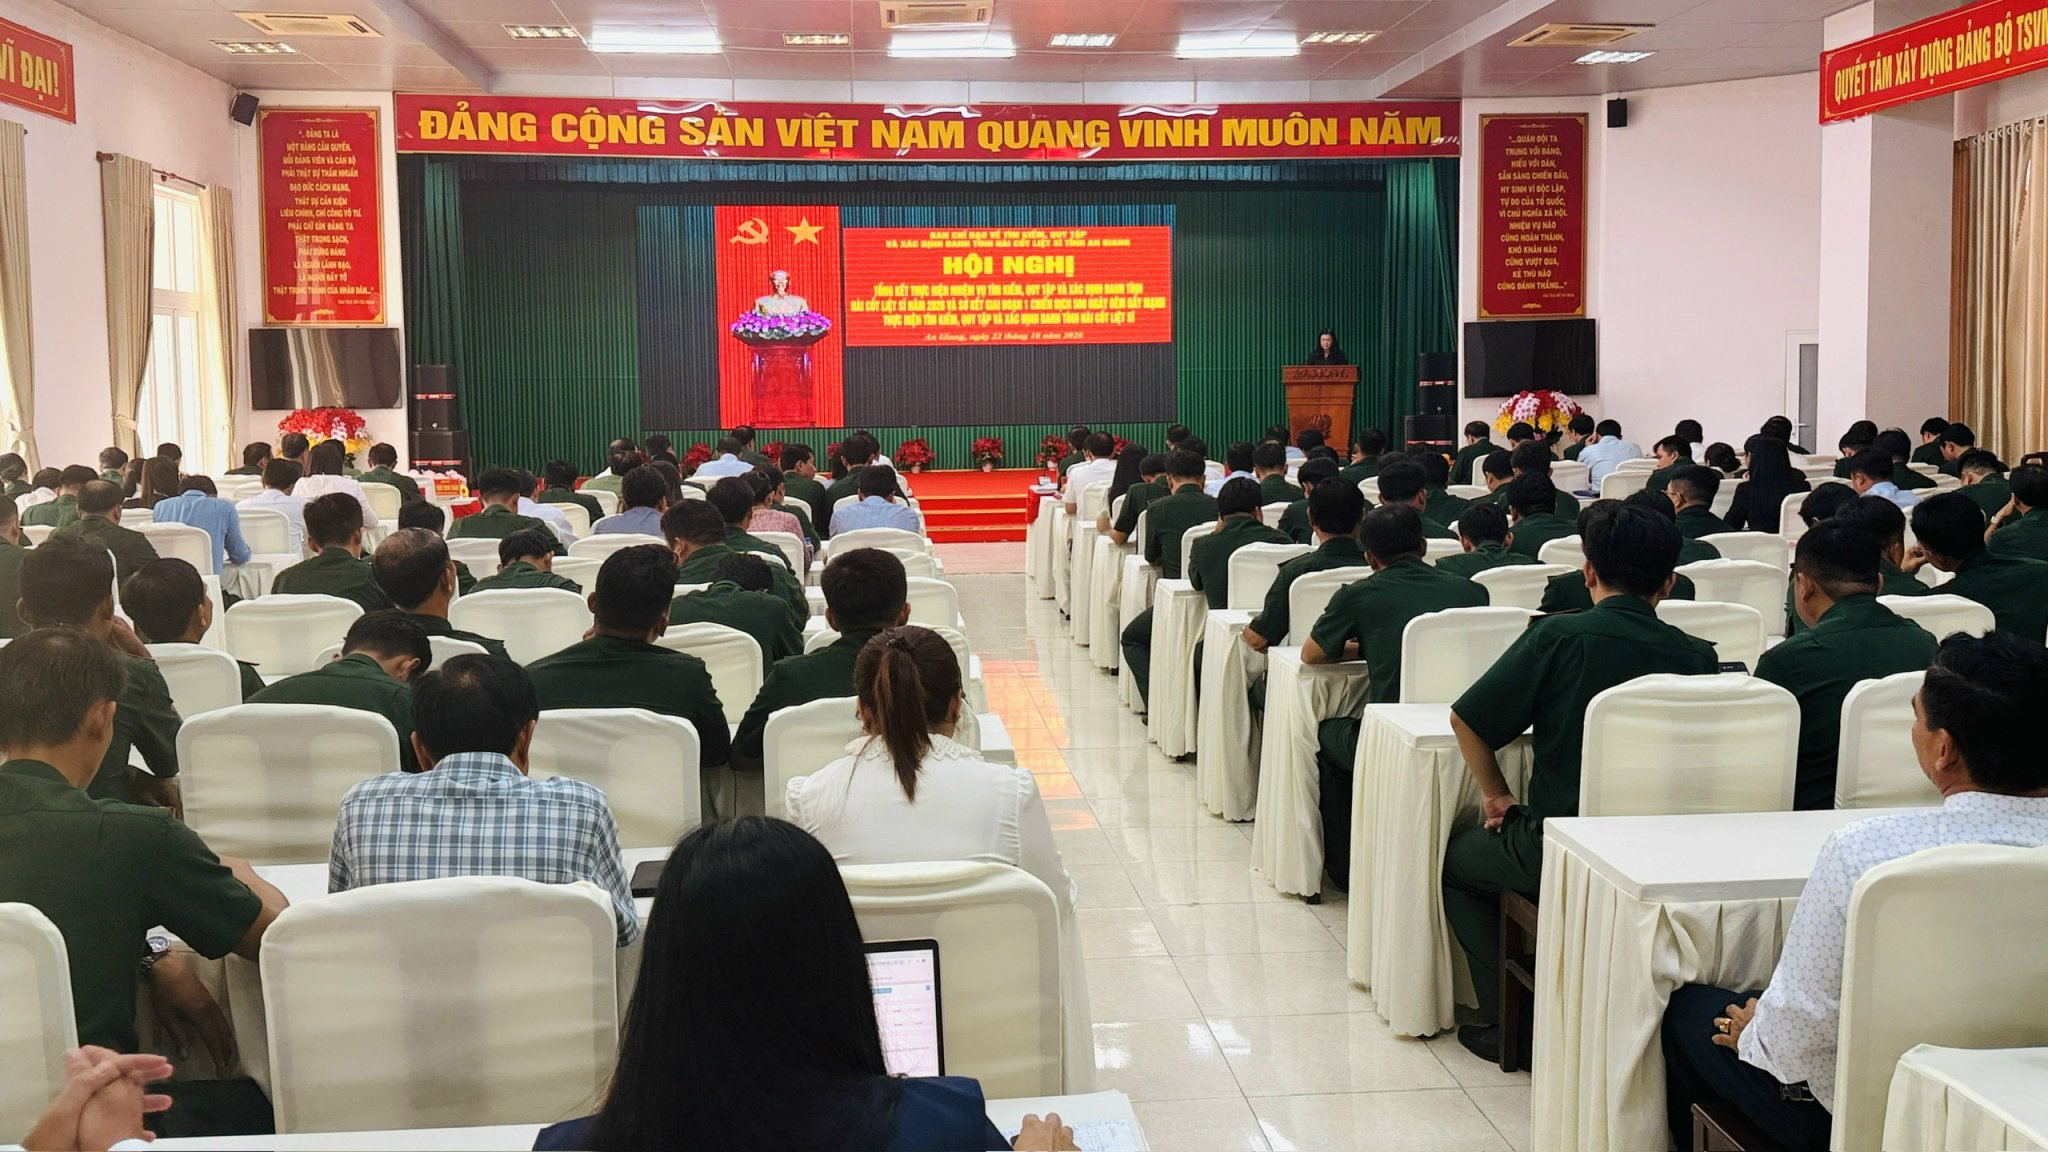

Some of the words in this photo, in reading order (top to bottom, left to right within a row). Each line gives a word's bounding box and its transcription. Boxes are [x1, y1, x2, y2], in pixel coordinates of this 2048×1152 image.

[20, 50, 59, 100] ĐẠI!
[1835, 53, 1867, 105] QUYẾT
[1869, 52, 1892, 93] TÂM
[1895, 43, 1918, 87] XÂY
[1921, 37, 1953, 84] DỰNG
[1956, 19, 1990, 70] ĐẢNG
[1995, 11, 2013, 64] BỘ
[418, 101, 537, 142] ĐẢNG
[551, 108, 666, 150] CỘNG
[776, 112, 859, 153] VIỆT
[872, 118, 964, 149] NAM
[978, 117, 1109, 151] QUANG
[1120, 119, 1209, 147] VINH
[1223, 112, 1337, 146] MUÔN
[1351, 111, 1442, 146] NĂM
[943, 253, 994, 278] HỘI
[1003, 255, 1075, 277] NGHỊ
